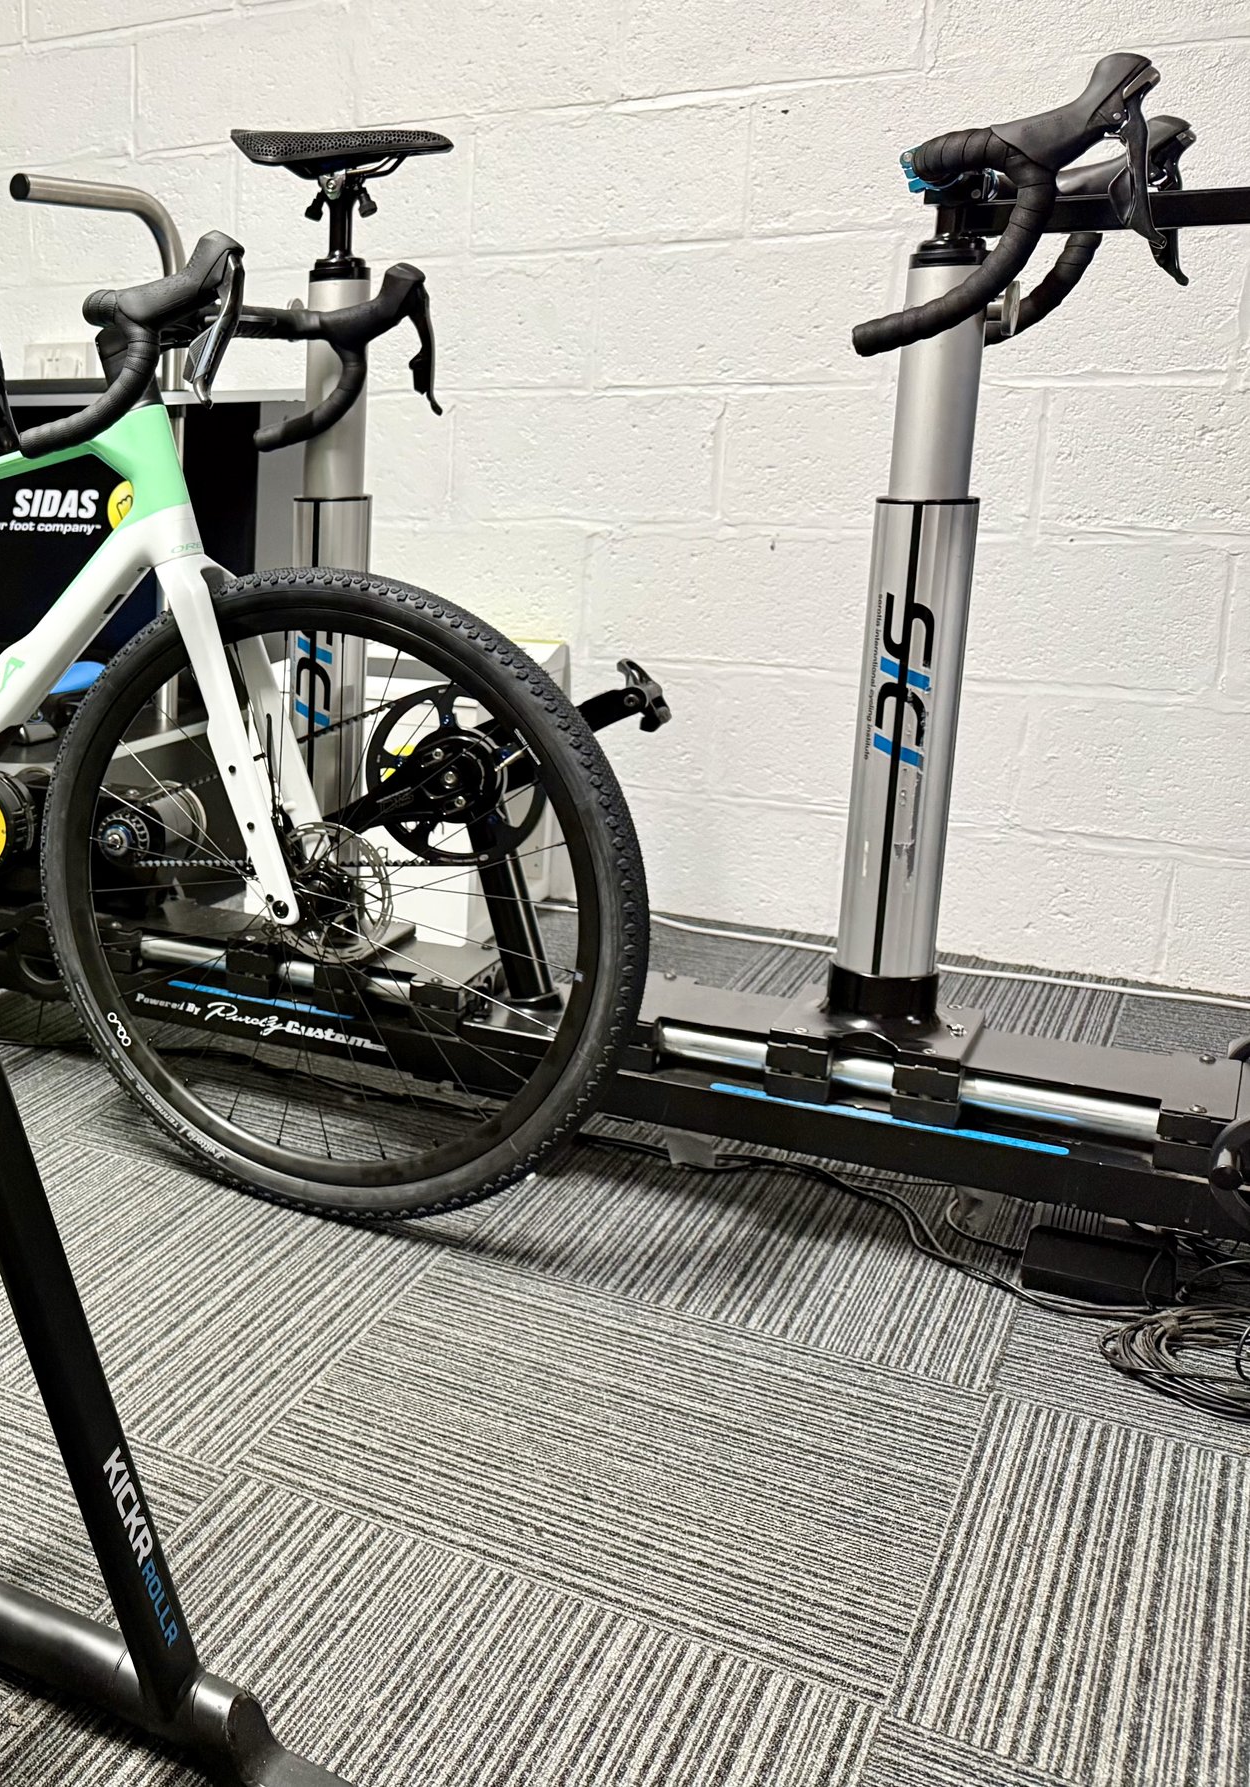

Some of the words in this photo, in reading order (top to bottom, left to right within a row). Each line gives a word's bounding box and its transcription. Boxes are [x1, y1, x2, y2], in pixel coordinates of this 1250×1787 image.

[12, 488, 100, 519] SIDAS
[8, 519, 36, 532] foot
[135, 992, 186, 1012] Powered
[185, 1002, 202, 1016] By
[102, 1445, 155, 1568] KICKR
[141, 1557, 180, 1649] ROLLR
